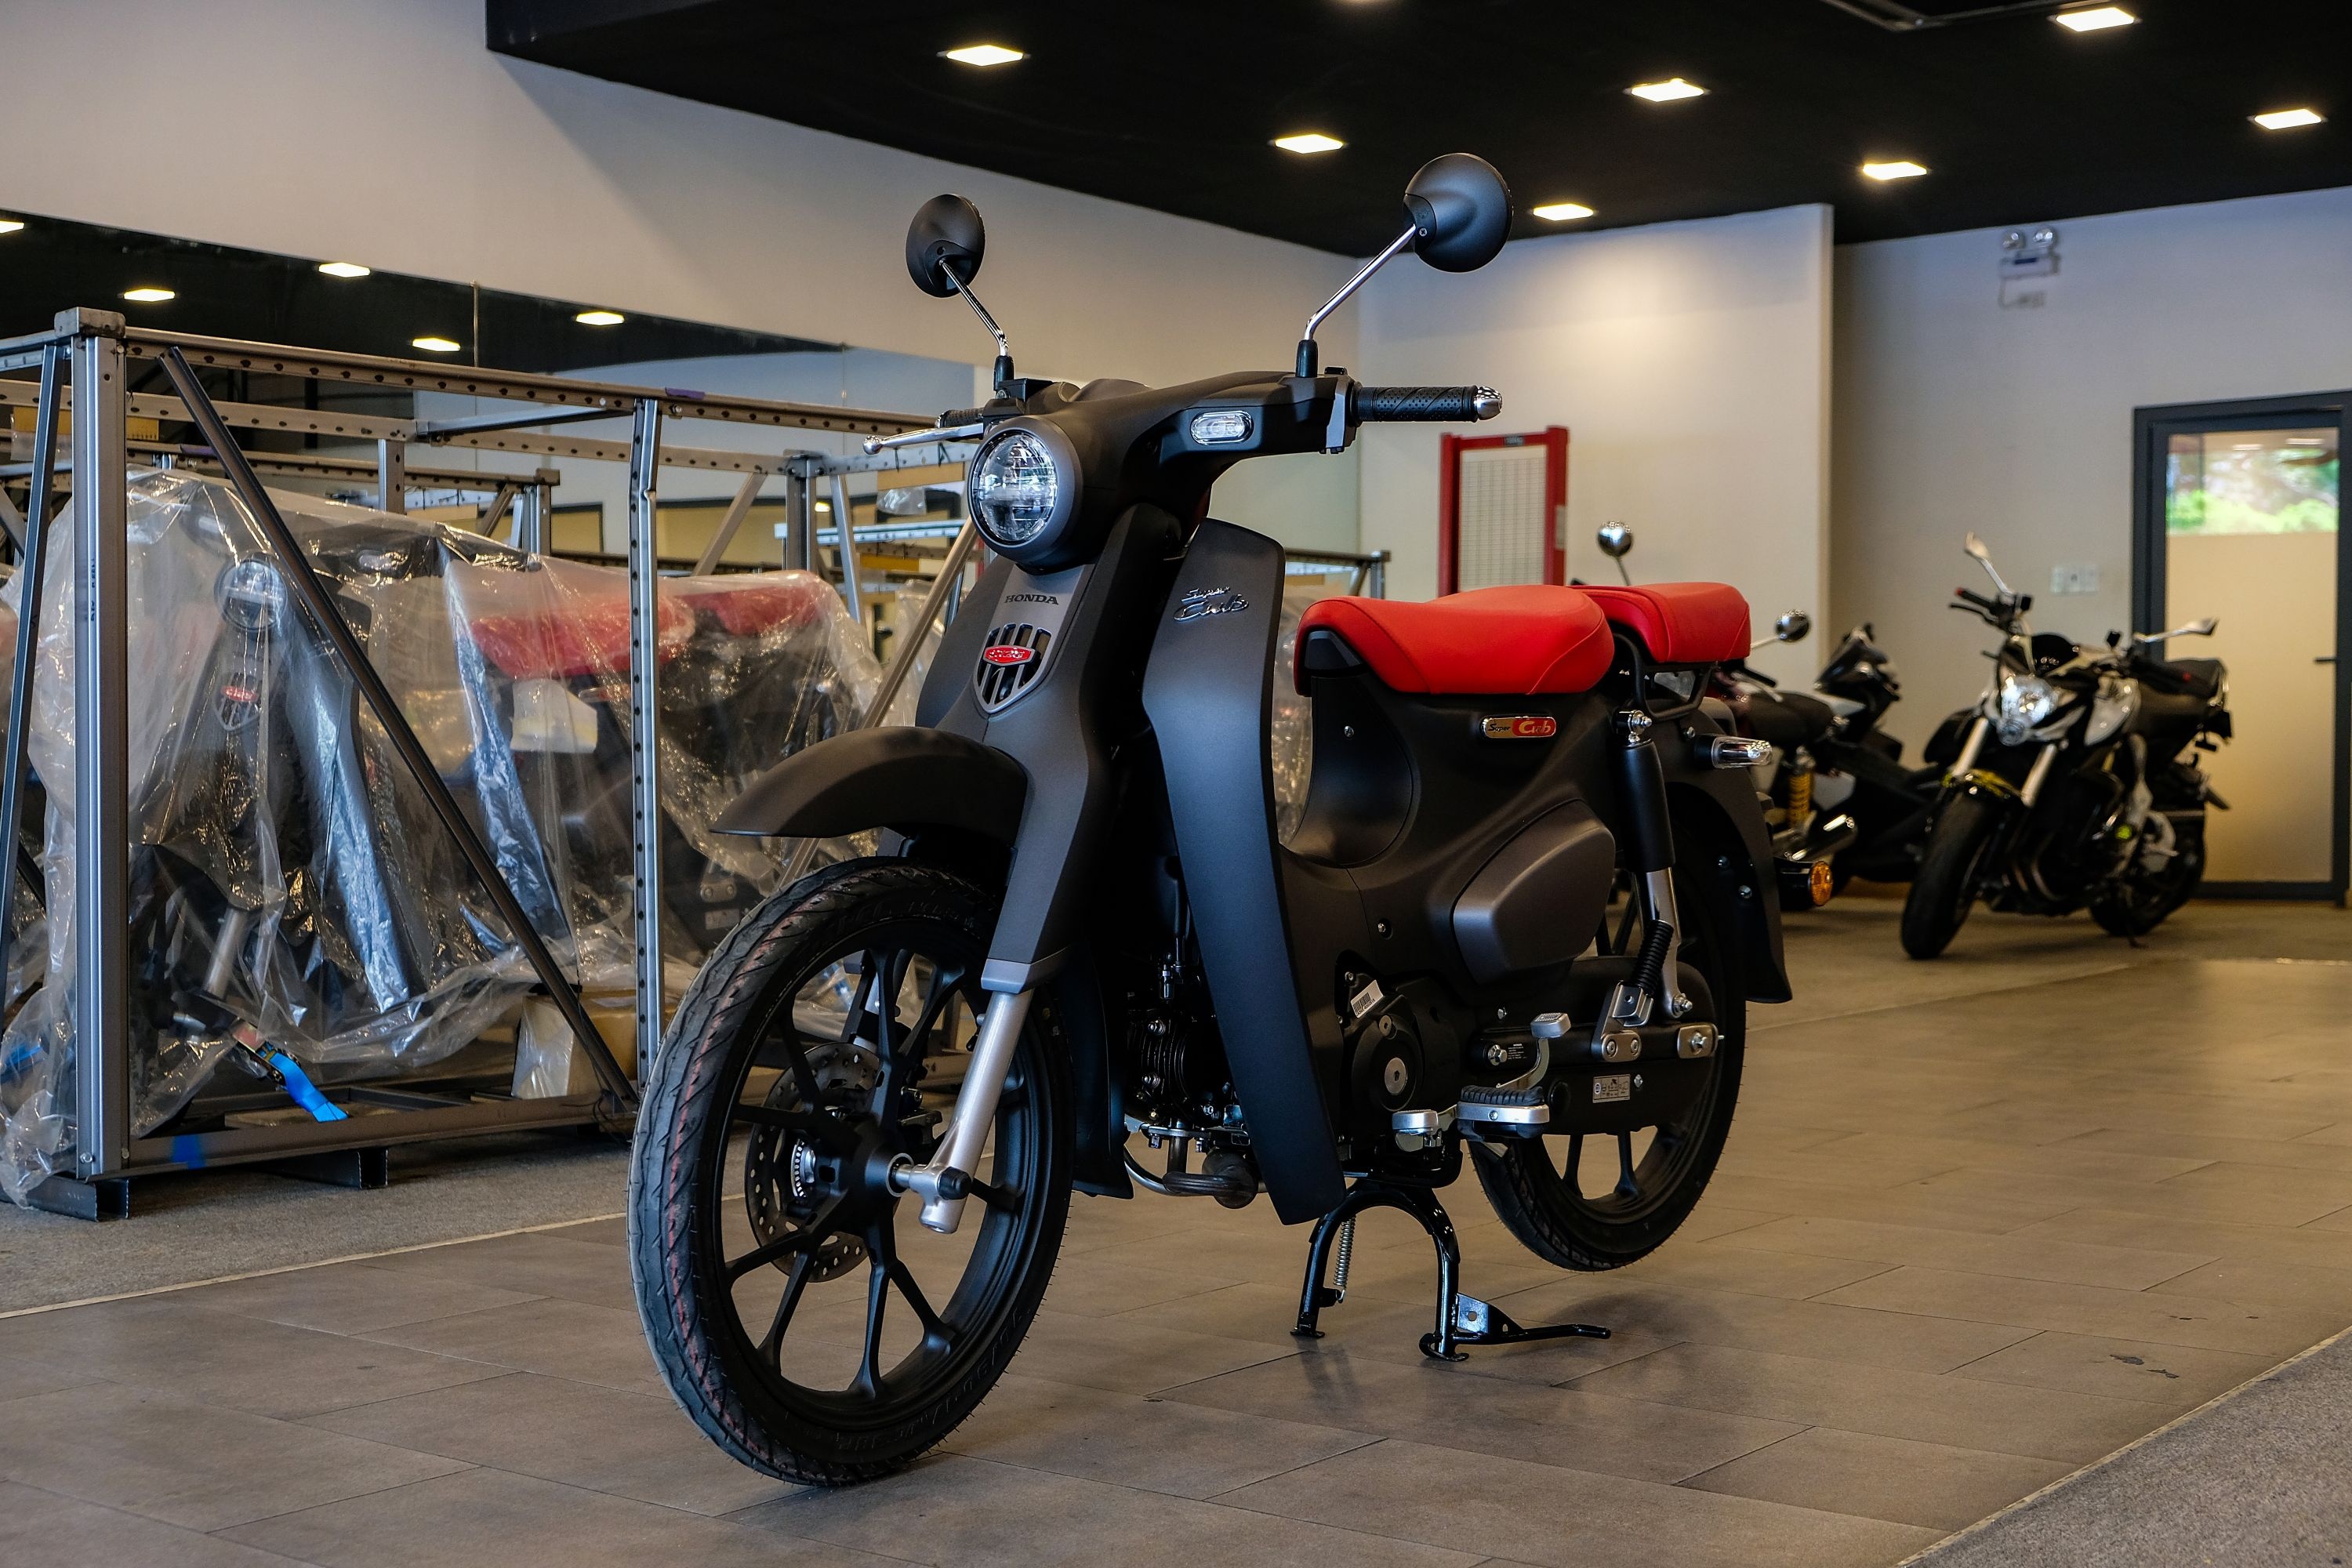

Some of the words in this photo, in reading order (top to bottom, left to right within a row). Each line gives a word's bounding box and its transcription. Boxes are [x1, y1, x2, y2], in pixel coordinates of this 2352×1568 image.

[1004, 593, 1059, 605] HONDA
[1174, 593, 1249, 622] Cub
[1488, 722, 1511, 733] Super
[1519, 720, 1552, 734] Cub
